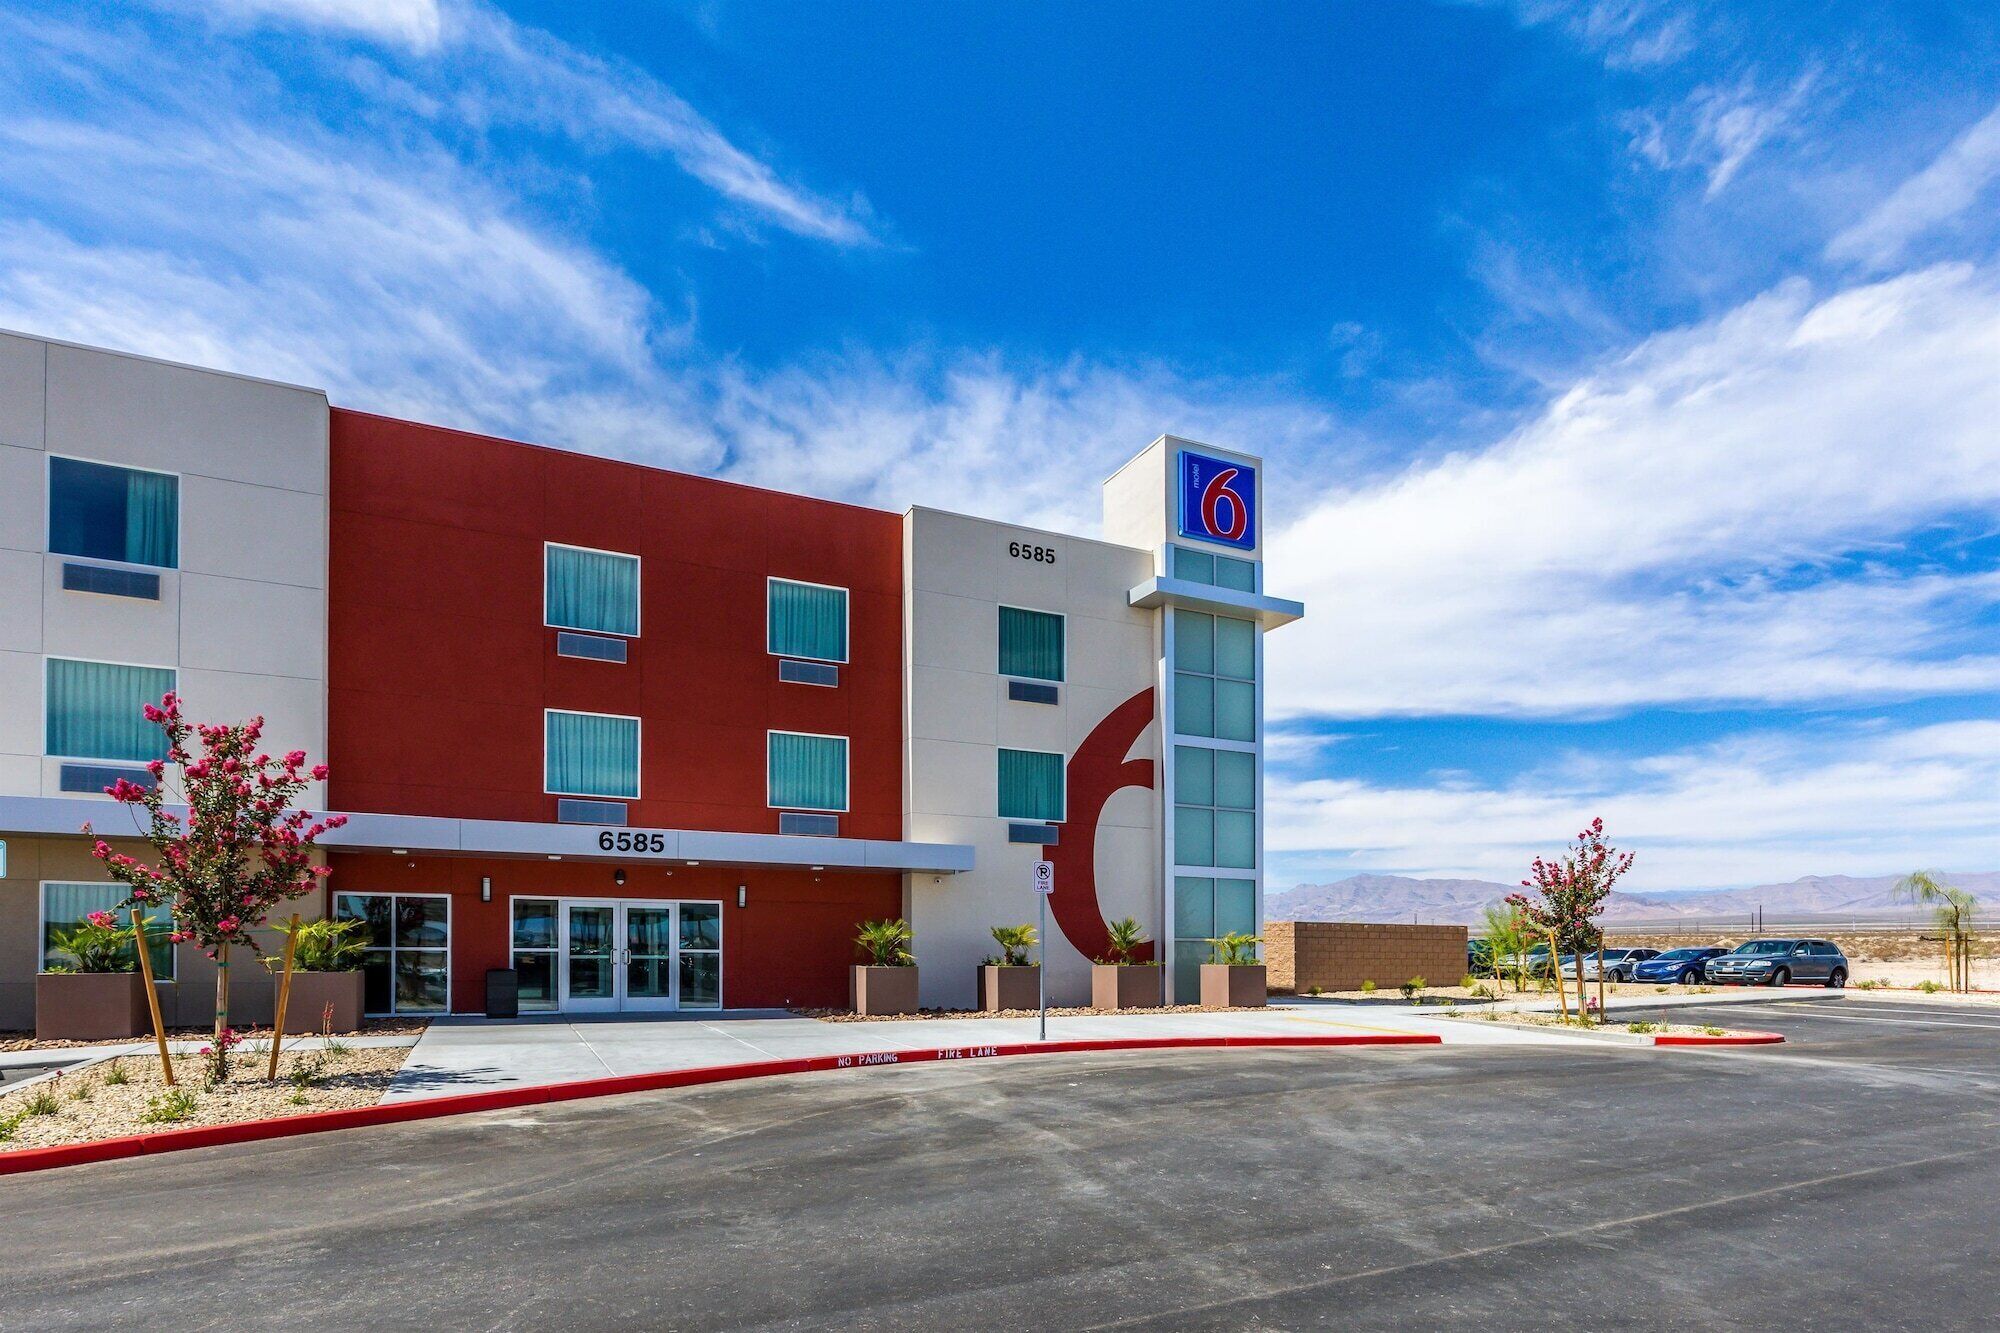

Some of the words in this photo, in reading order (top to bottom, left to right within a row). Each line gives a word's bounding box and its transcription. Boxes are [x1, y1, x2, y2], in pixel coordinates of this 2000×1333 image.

[1192, 463, 1200, 489] motel
[1201, 468, 1247, 541] 6
[1009, 541, 1056, 564] 6585
[599, 831, 665, 853] 6585
[838, 1056, 852, 1067] NO
[858, 1052, 898, 1065] PARKING
[938, 1048, 963, 1060] FIRE
[970, 1046, 998, 1058] LANE
